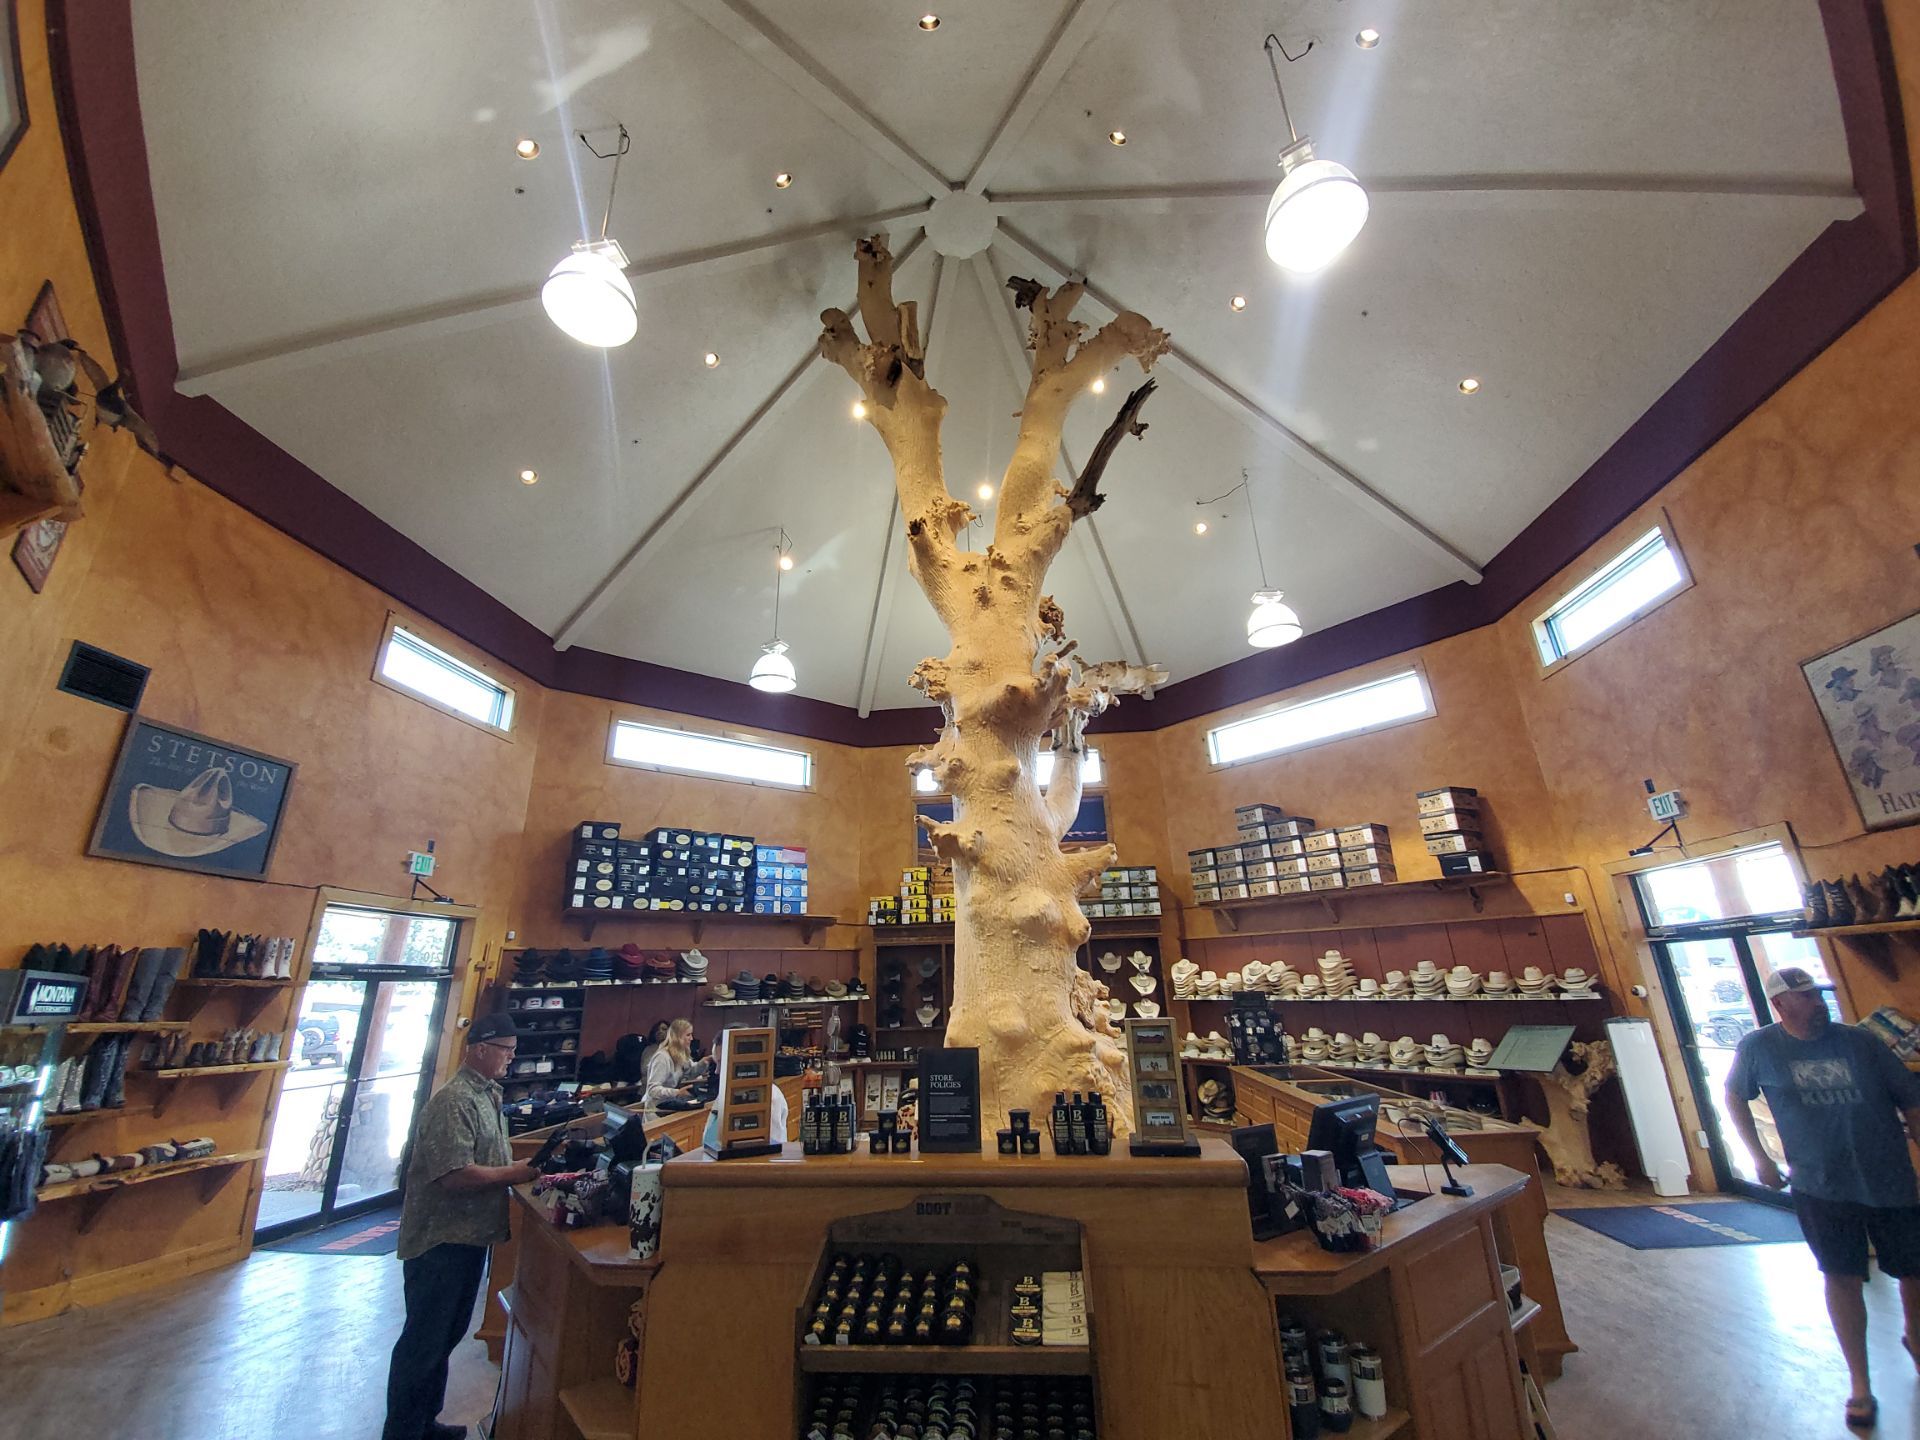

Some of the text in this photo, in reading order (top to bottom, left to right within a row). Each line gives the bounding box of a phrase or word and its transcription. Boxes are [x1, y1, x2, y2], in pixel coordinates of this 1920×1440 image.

[148, 735, 279, 784] STETSON
[1652, 794, 1674, 816] EXIT
[415, 855, 433, 873] EXIT
[916, 1202, 951, 1216] BOOT
